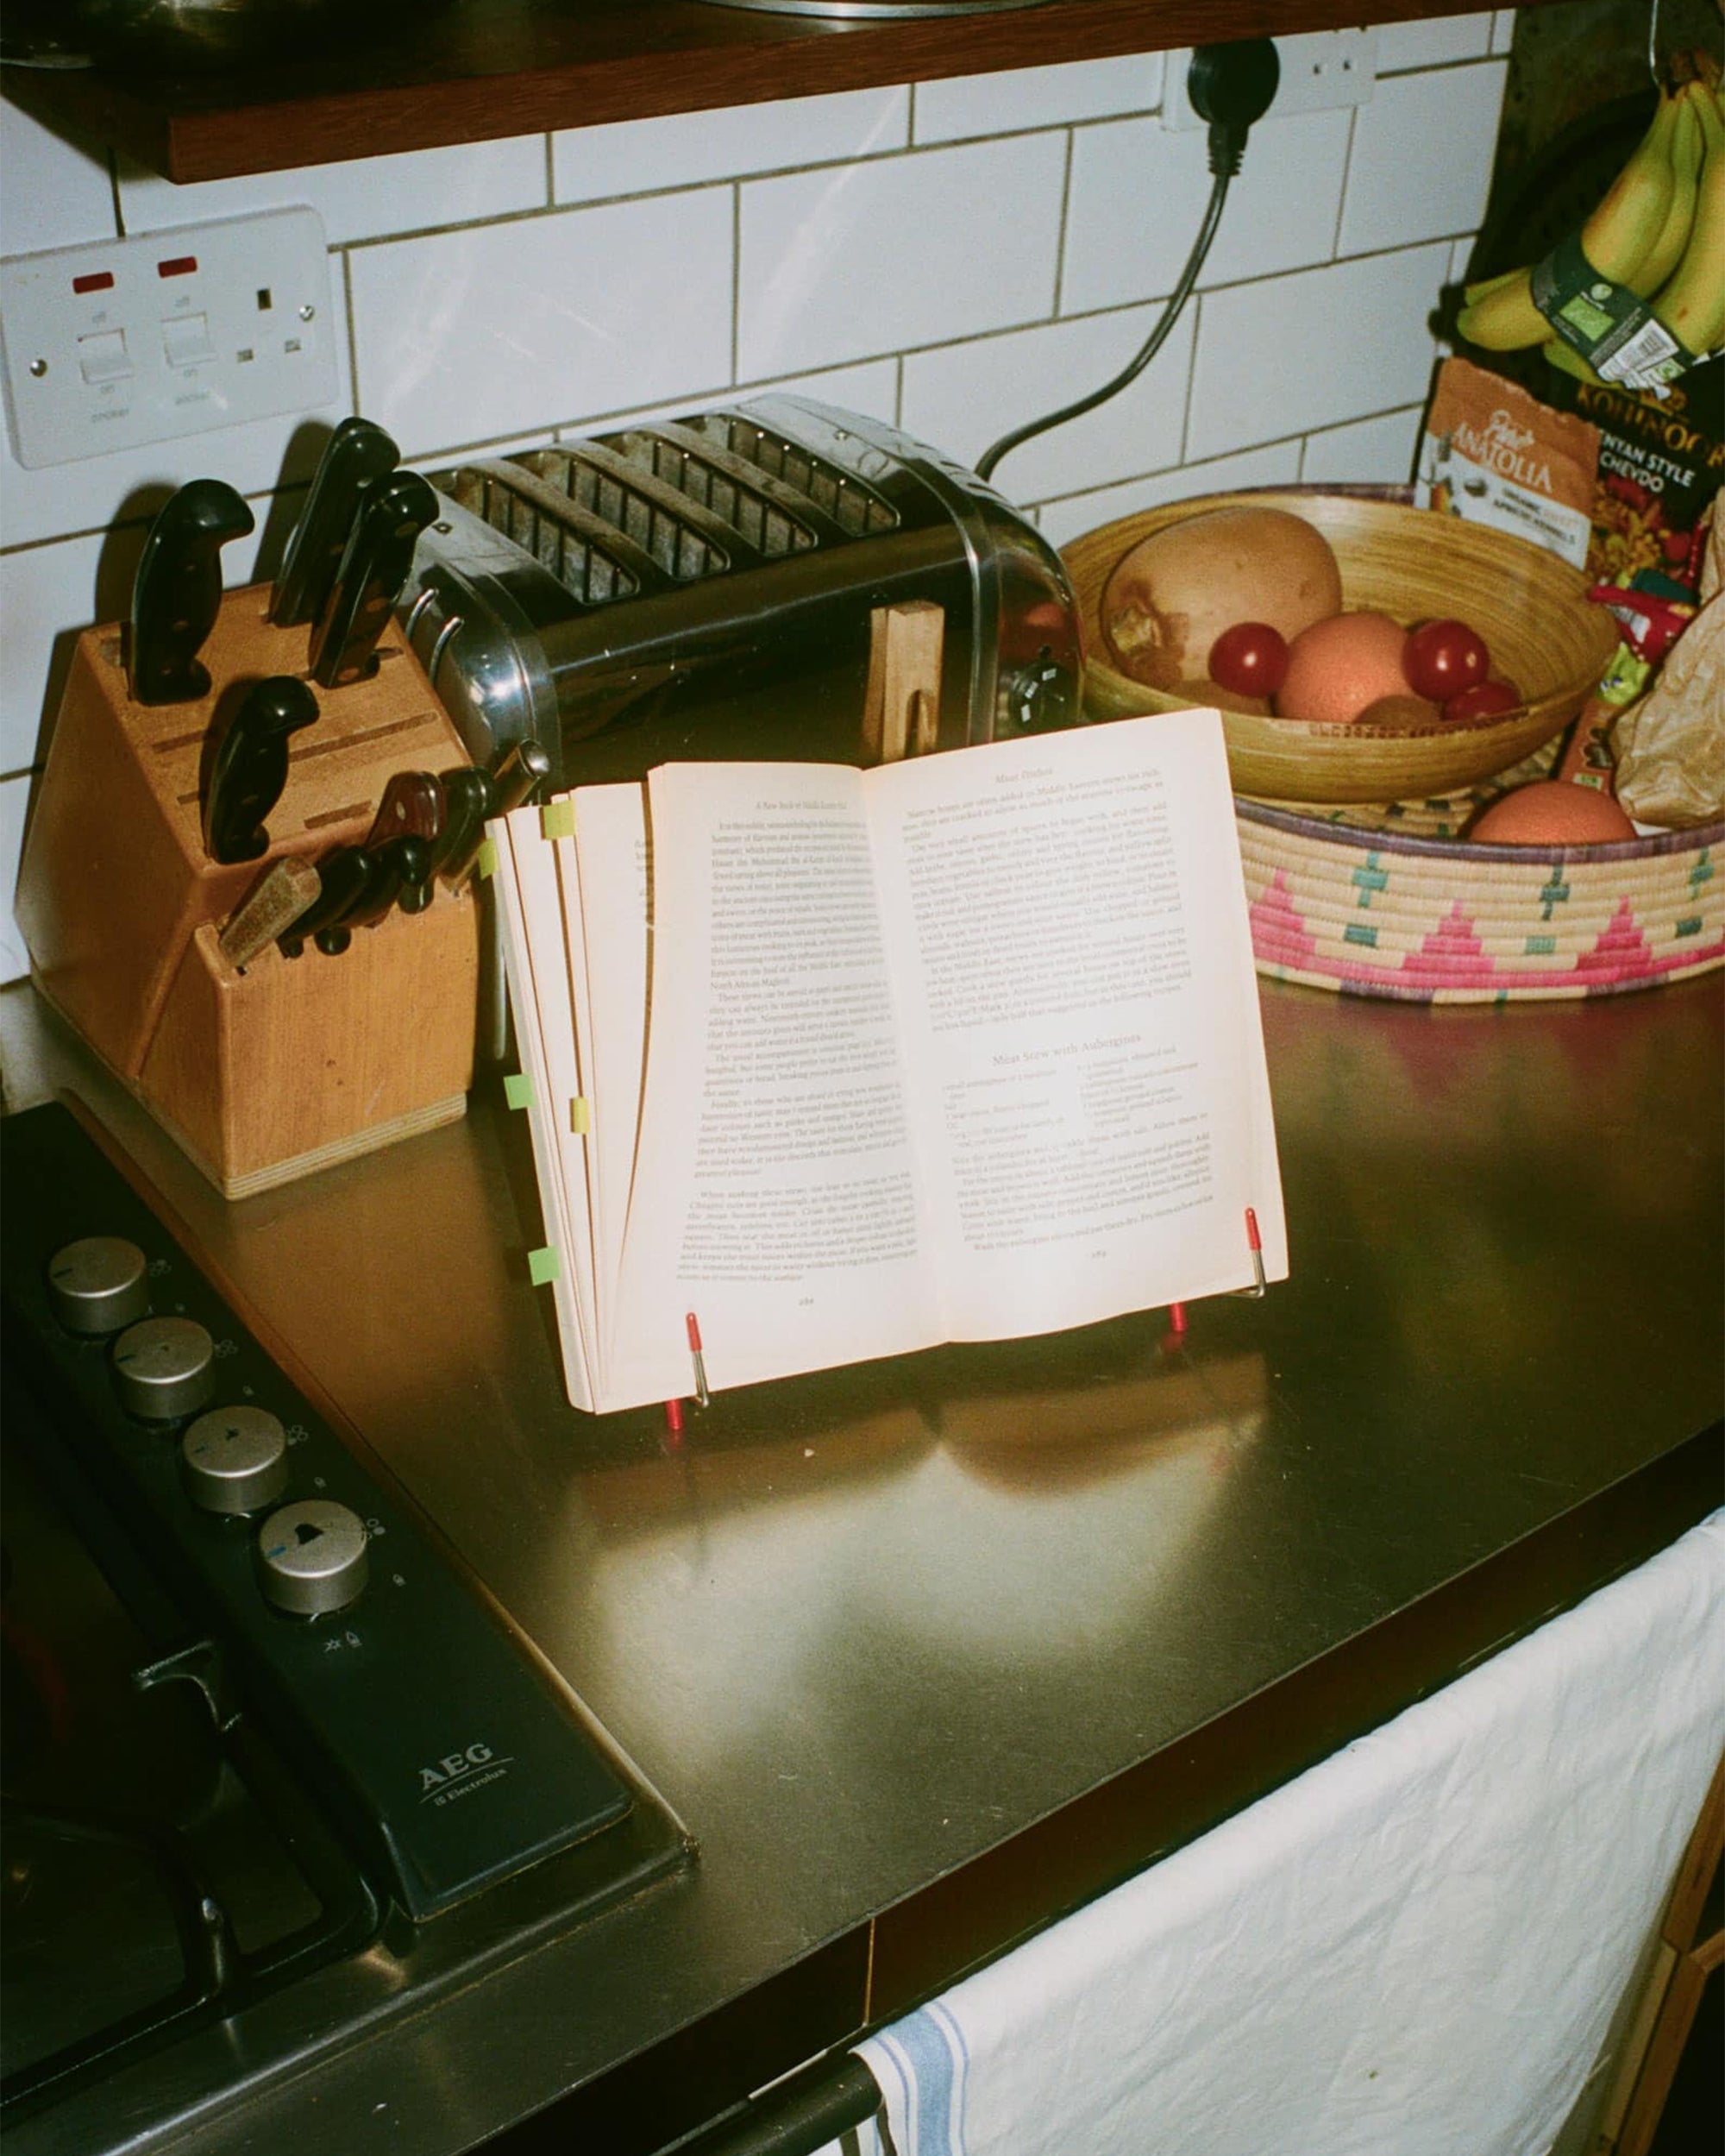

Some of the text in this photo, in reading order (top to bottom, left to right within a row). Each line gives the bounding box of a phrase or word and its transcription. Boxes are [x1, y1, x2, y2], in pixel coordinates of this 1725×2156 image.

[1452, 421, 1553, 494] ANATOLIA
[1646, 452, 1696, 488] STYLE
[418, 1742, 493, 1791] AEG
[448, 1768, 507, 1801] Electrolux
